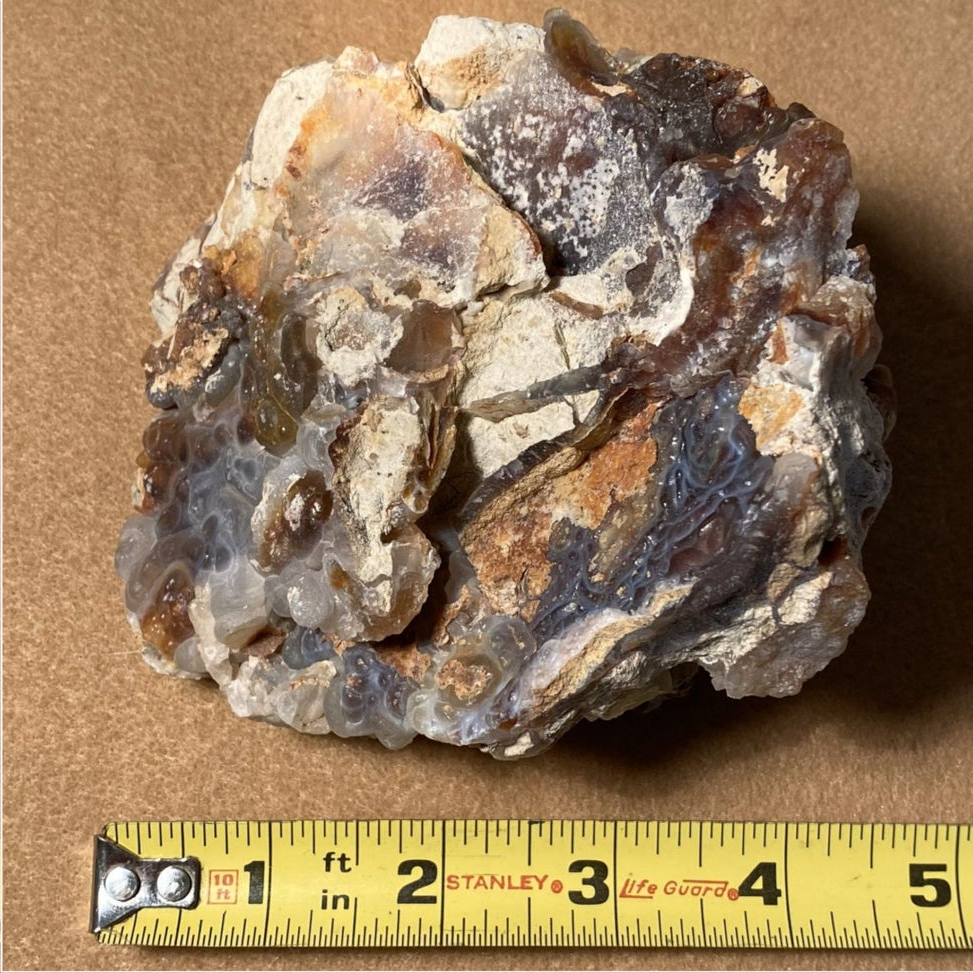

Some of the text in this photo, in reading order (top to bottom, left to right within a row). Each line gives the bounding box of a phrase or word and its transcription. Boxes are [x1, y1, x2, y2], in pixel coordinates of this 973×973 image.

[214, 875, 233, 886] 10
[244, 861, 265, 904] 1
[323, 853, 351, 872] ft
[397, 860, 438, 904] 2
[568, 860, 609, 905] 3
[738, 862, 782, 905] 4
[216, 888, 231, 900] ft
[322, 891, 349, 910] in
[909, 864, 952, 907] 5
